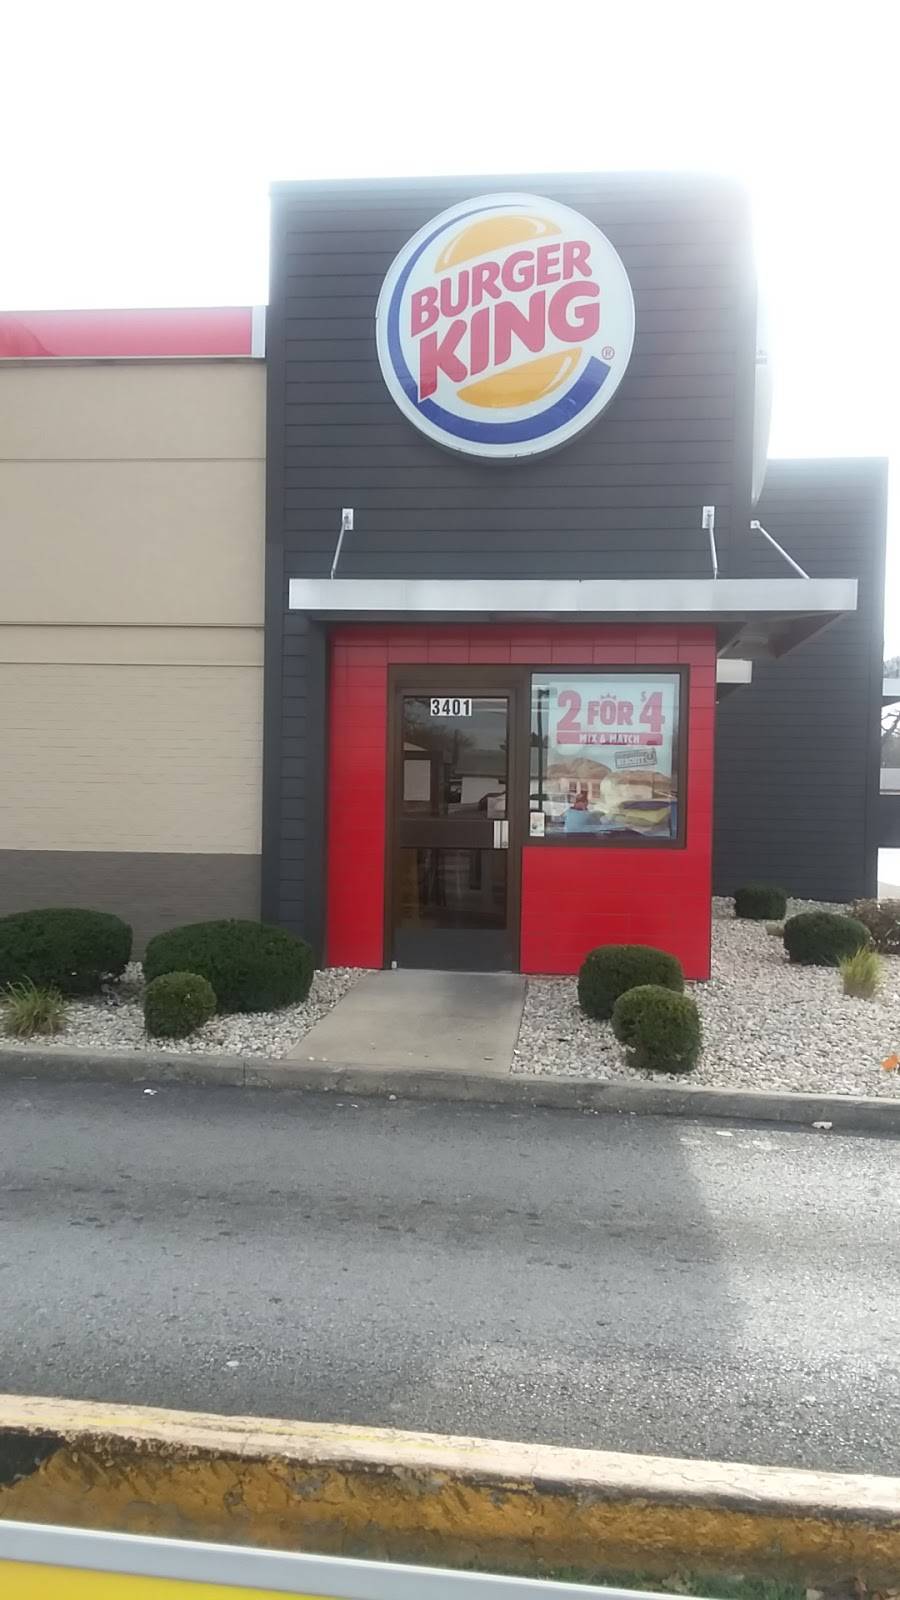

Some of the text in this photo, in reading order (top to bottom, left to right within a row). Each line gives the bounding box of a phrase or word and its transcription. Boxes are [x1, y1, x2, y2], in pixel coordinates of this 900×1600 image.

[411, 240, 593, 337] BURGER
[420, 280, 600, 400] KING
[431, 699, 470, 716] 3401
[556, 690, 582, 731] 2
[587, 700, 634, 726] FOR
[579, 734, 597, 744] MIX
[609, 734, 640, 744] MATCH
